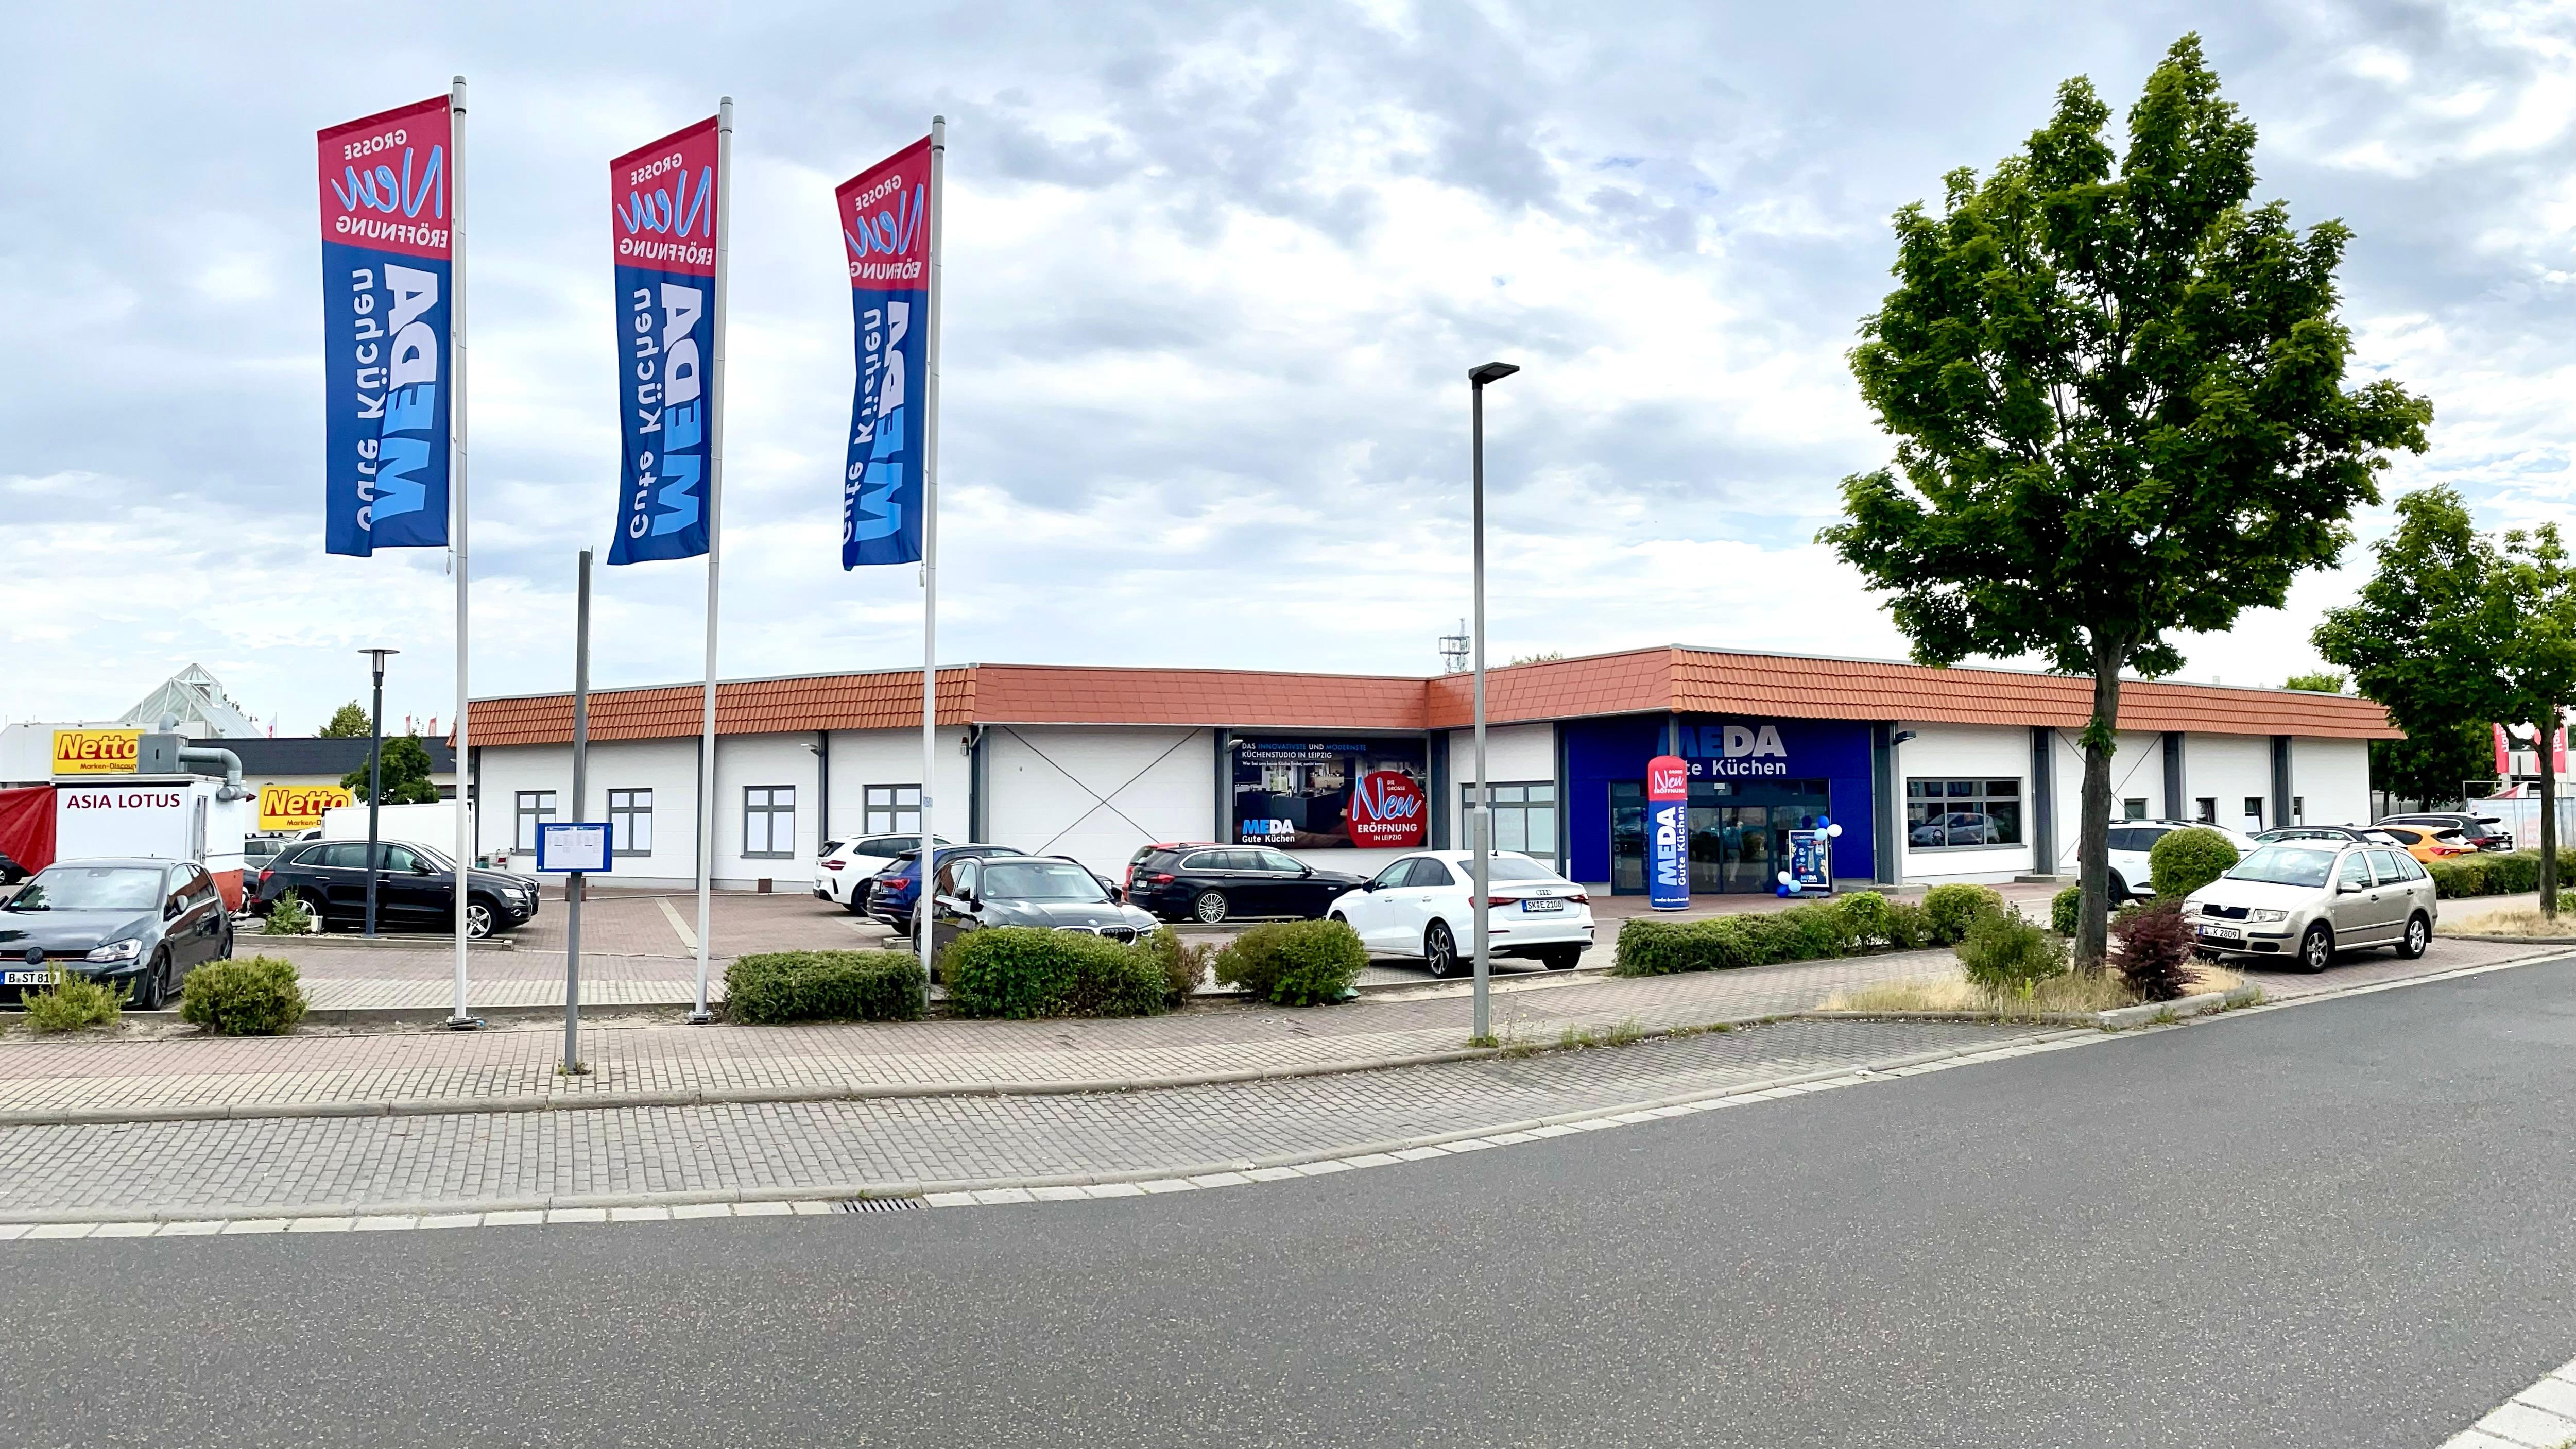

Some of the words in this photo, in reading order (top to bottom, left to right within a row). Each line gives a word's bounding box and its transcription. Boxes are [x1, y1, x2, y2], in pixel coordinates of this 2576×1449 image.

[57, 734, 138, 760] Netto
[1242, 750, 1296, 758] KÜCHENSTUDIO
[1712, 759, 1787, 775] Küchen
[66, 794, 112, 809] ASIA
[118, 793, 180, 808] LOTUS
[263, 789, 348, 816] Netto
[1352, 775, 1422, 821] Neu
[1242, 819, 1295, 834] MEDA
[1358, 822, 1418, 833] ERÖFFNUNG
[1676, 806, 1686, 852] Küchen
[1242, 834, 1261, 843] Gute
[1265, 834, 1295, 843] Küchen
[1656, 806, 1678, 886] MEDA
[1678, 856, 1687, 886] Gute
[2220, 929, 2237, 939] 2809
[9, 973, 15, 983] B
